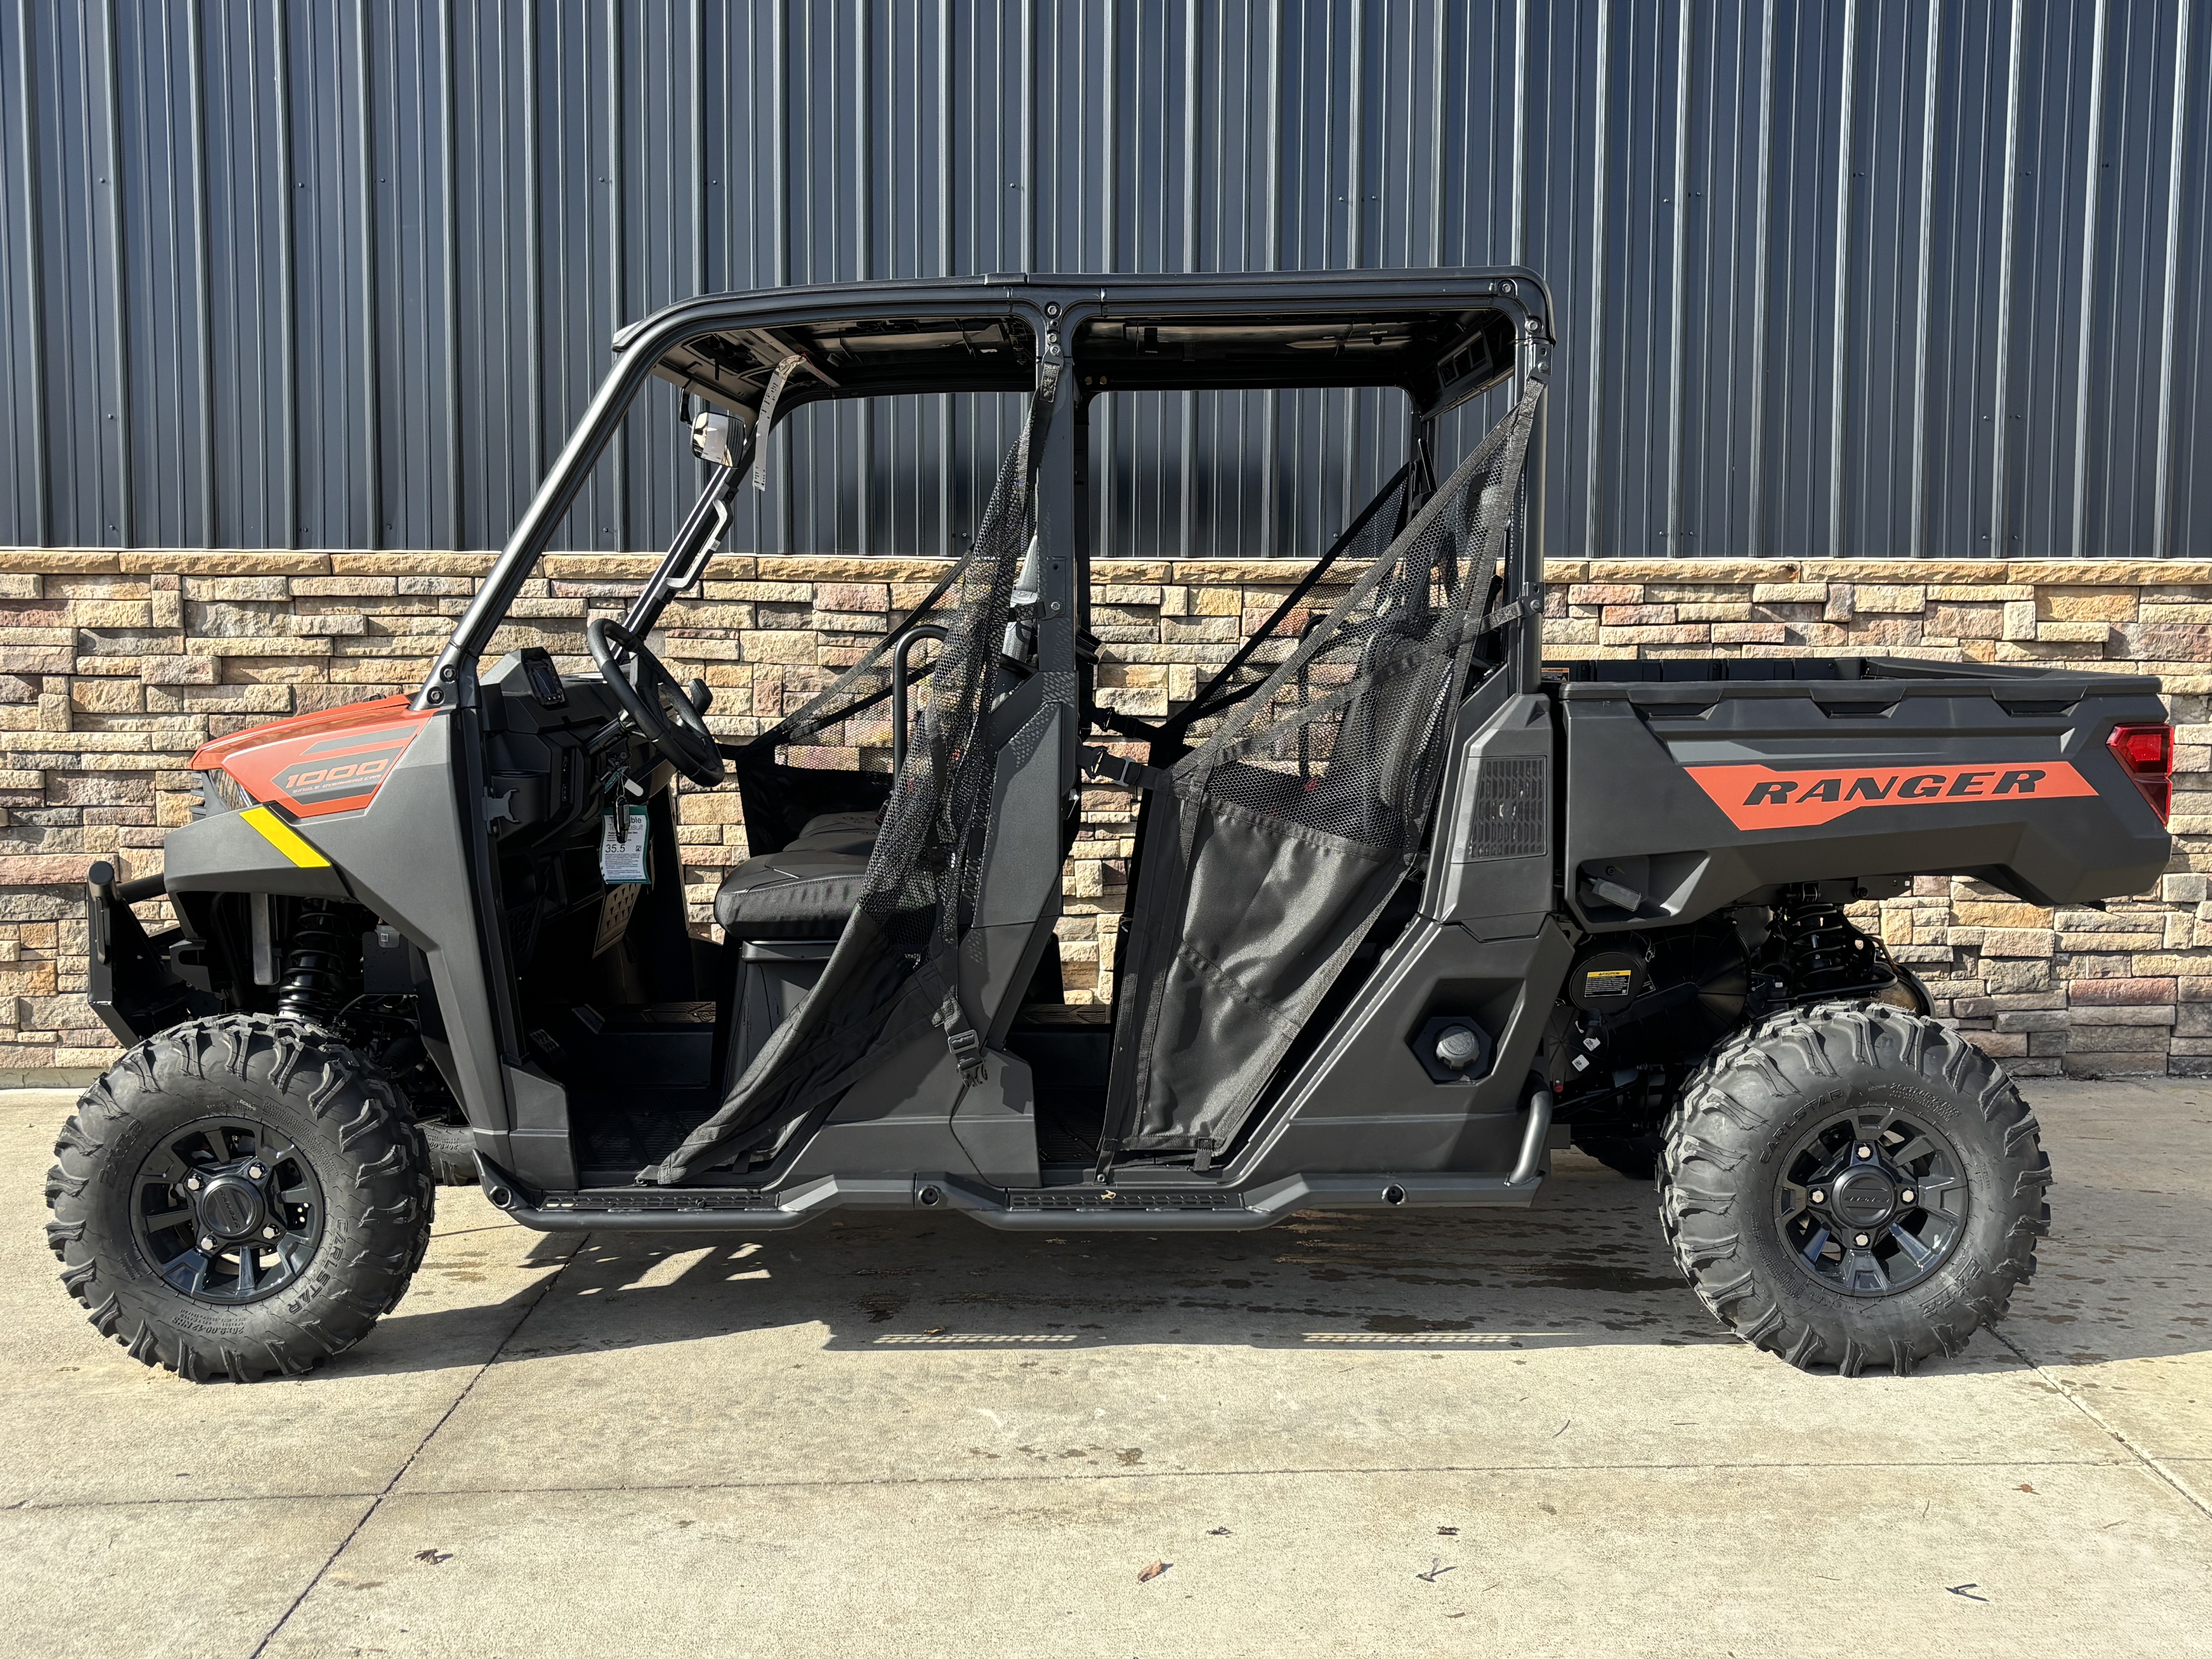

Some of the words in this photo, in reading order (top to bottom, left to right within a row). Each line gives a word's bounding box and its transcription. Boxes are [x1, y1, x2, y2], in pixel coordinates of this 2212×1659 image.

[286, 759, 388, 788] 1000
[292, 785, 320, 793] SINGLE
[322, 778, 363, 788] OVERHEAD
[1742, 769, 2047, 807] RANGER
[605, 844, 626, 853] 35.5
[1759, 1089, 1843, 1164] CARLSTAR
[287, 1218, 349, 1314] CARLSTAR
